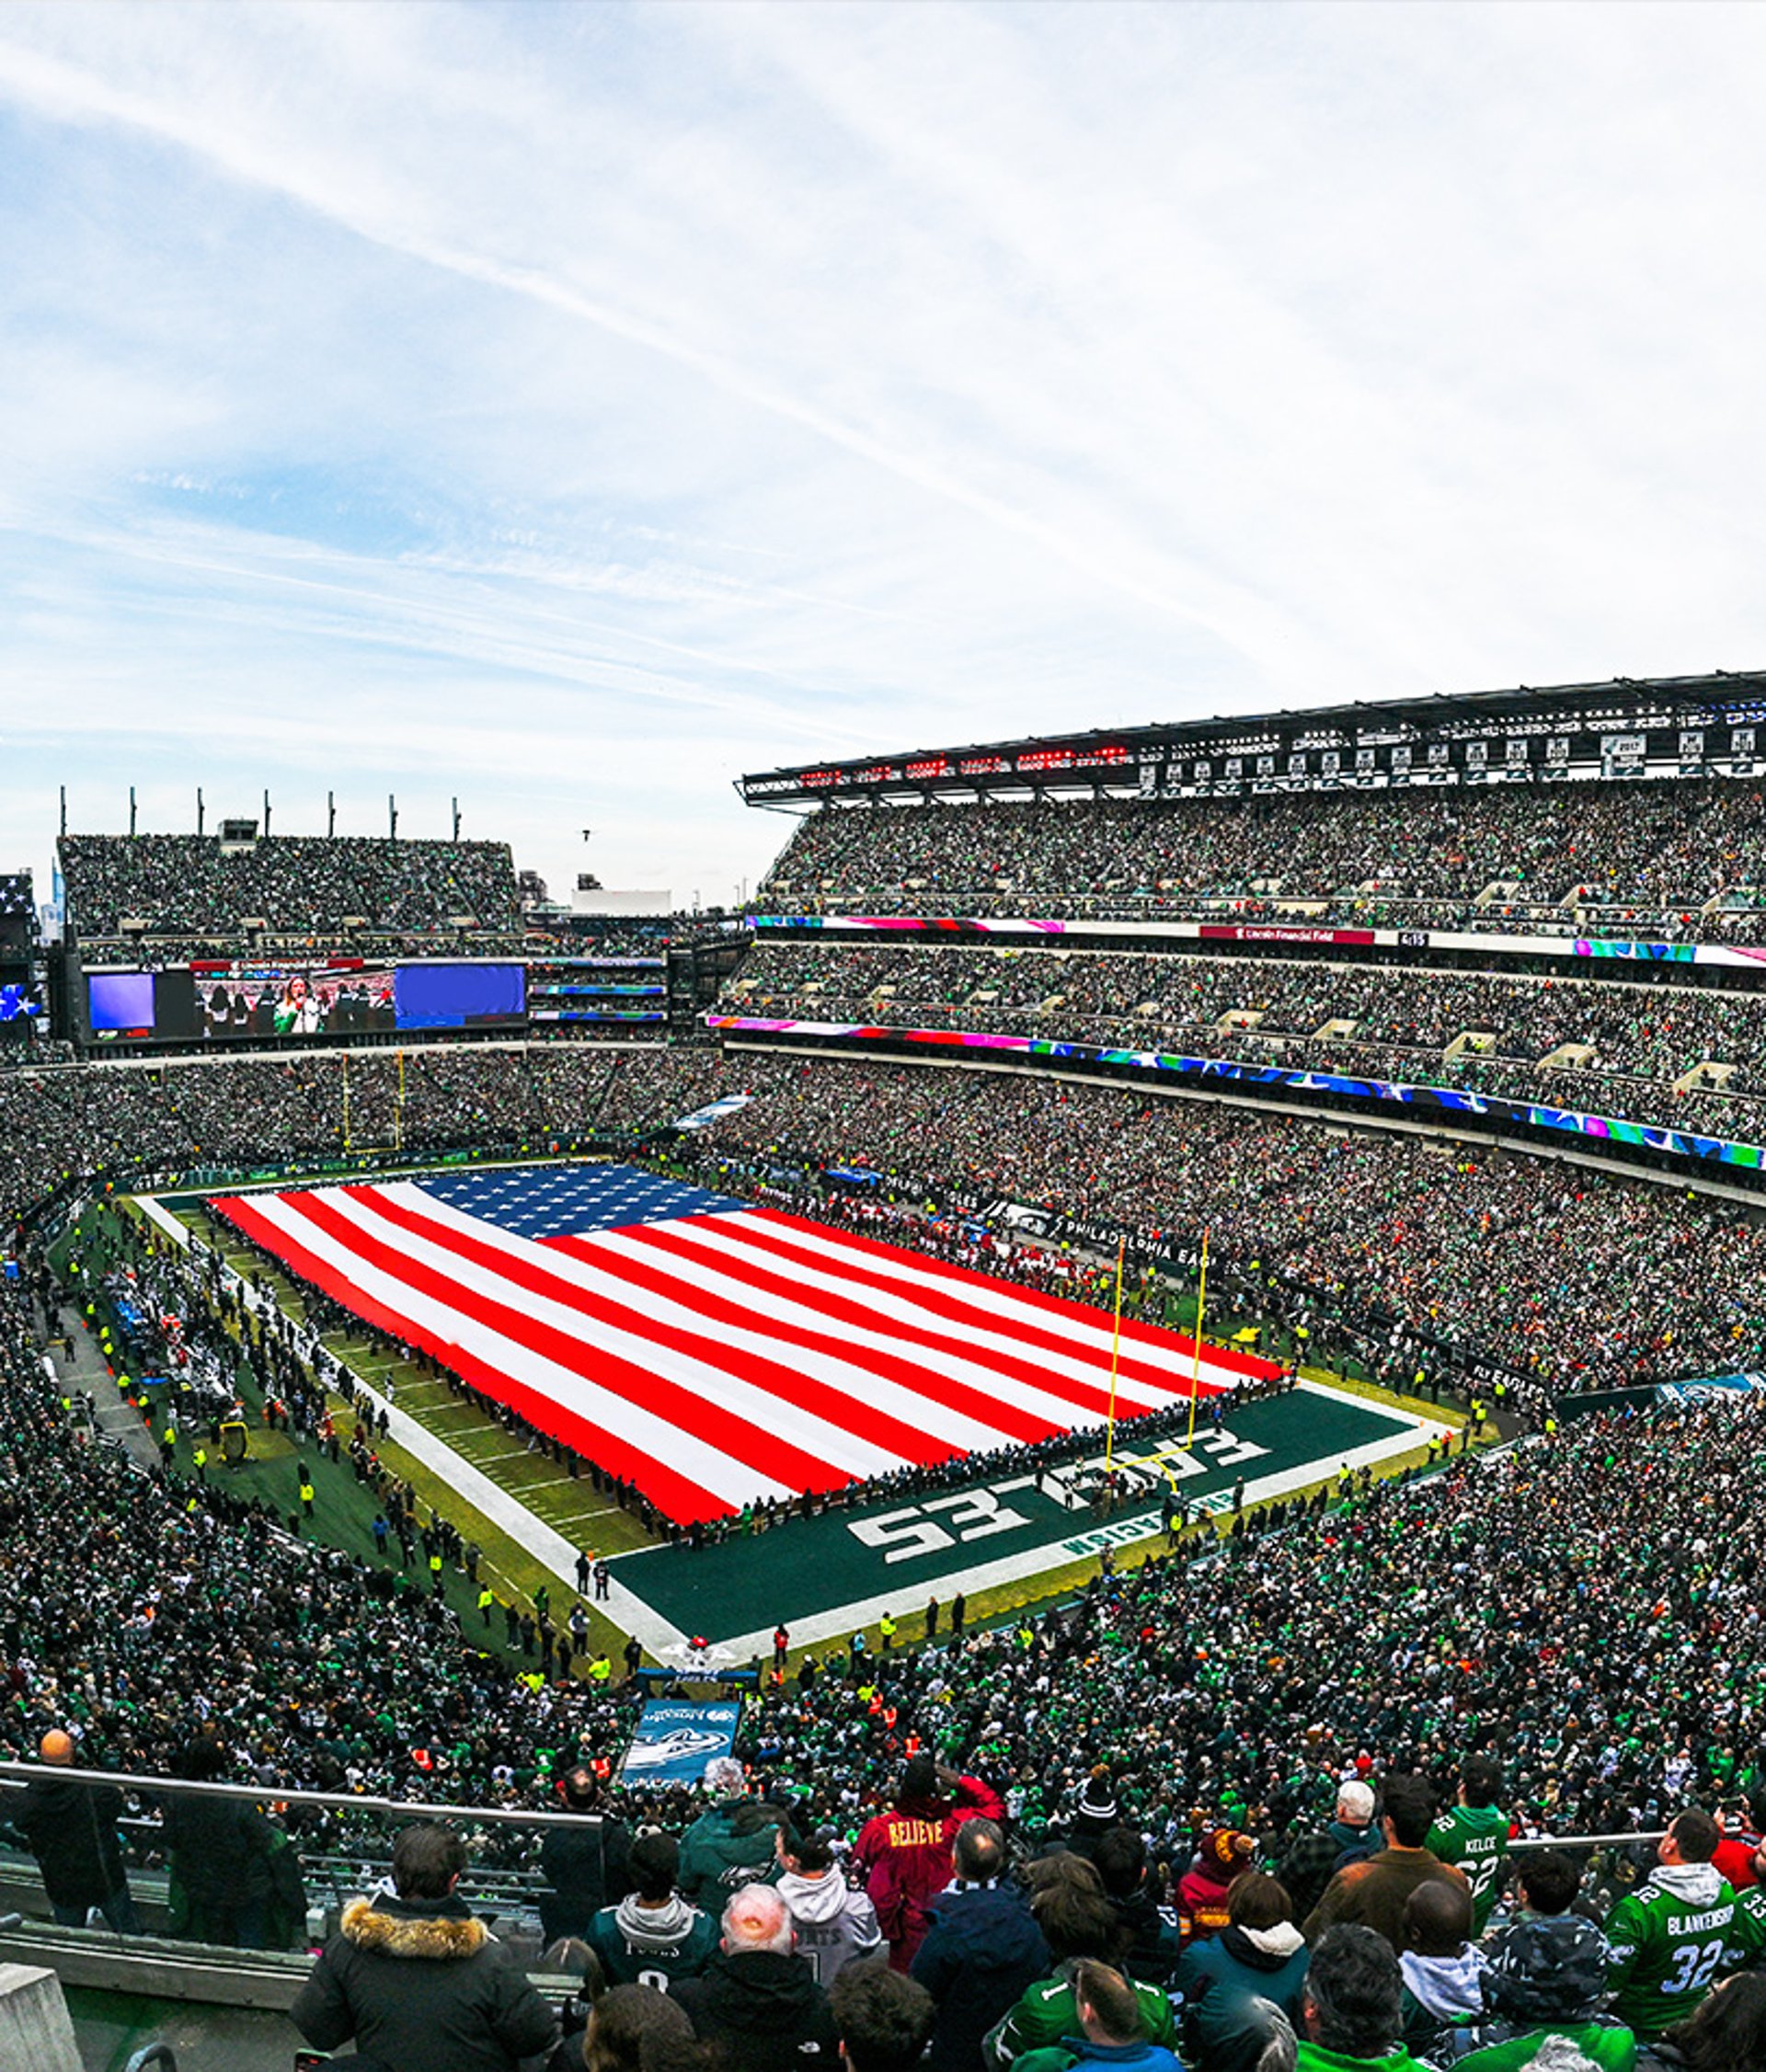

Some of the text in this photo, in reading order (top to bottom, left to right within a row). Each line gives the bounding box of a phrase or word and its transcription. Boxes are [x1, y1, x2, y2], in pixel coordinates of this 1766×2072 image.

[1276, 930, 1313, 942] Financial
[1313, 931, 1335, 943] Field
[1473, 1364, 1491, 1379] FLY
[888, 1819, 945, 1848] BELIEVE
[1464, 1835, 1497, 1854] KELCE
[795, 1927, 843, 1947] URTS
[1660, 1938, 1724, 1994] 32
